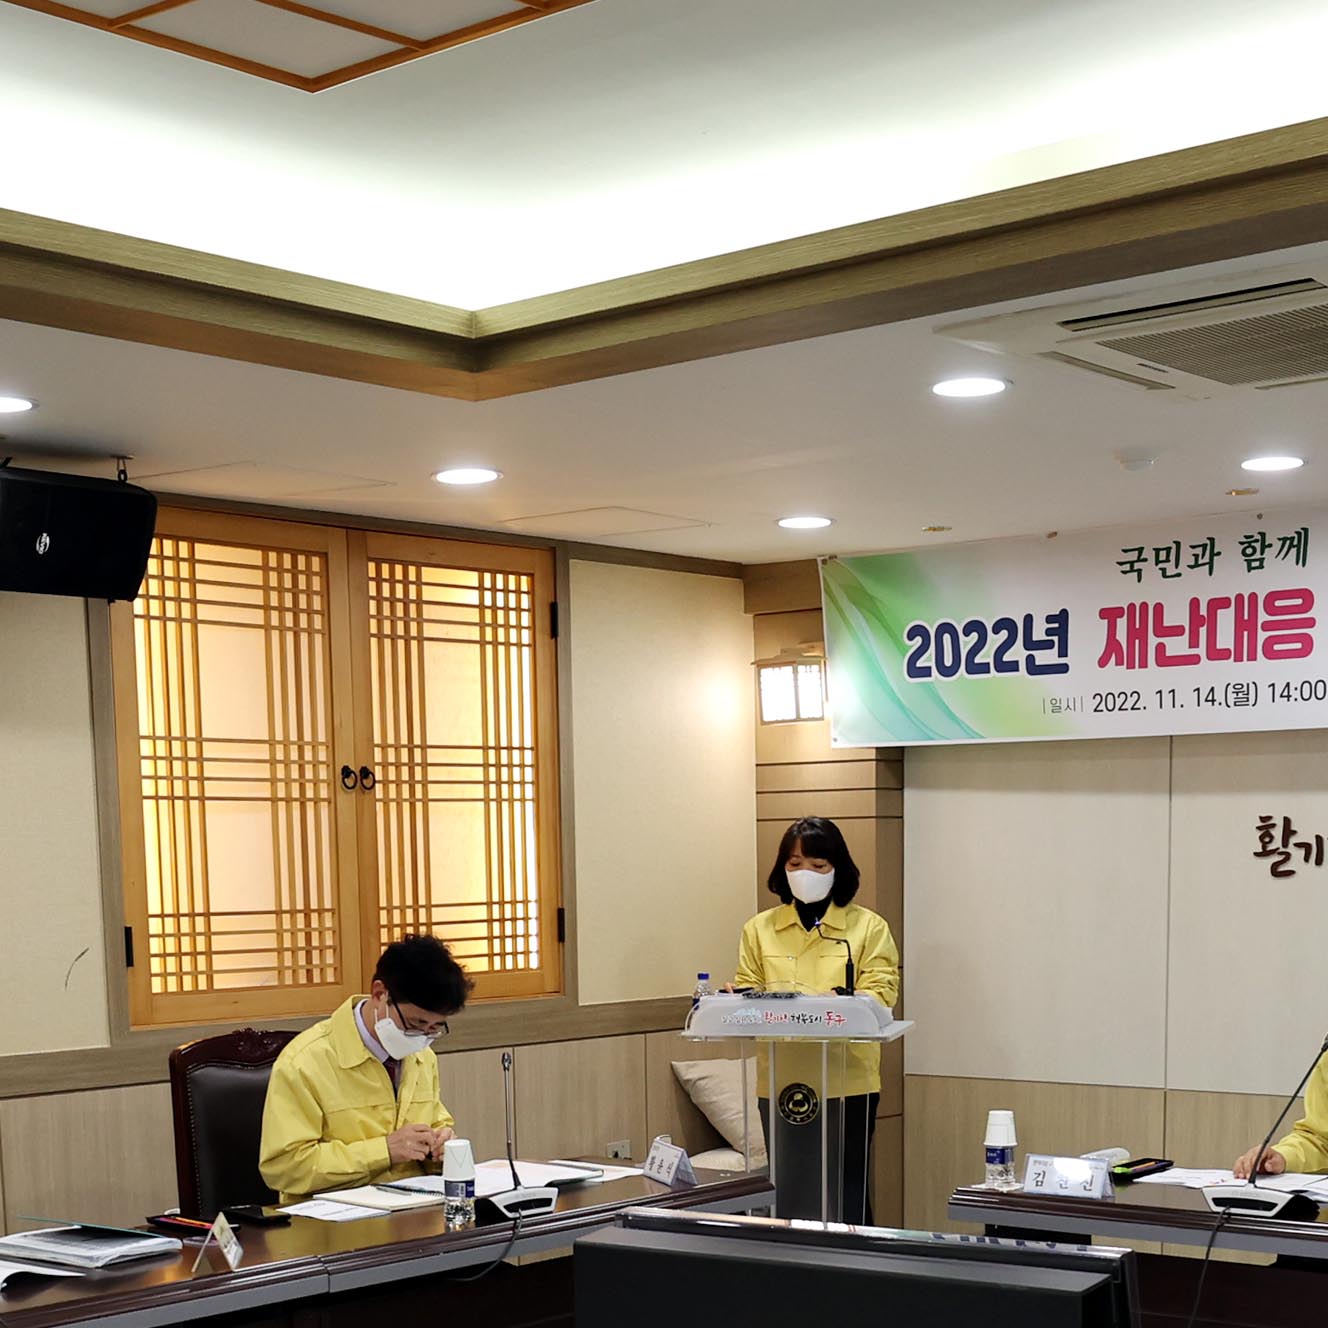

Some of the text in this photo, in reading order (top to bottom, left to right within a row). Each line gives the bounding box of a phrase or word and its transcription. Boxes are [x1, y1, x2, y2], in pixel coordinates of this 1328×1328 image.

[1116, 536, 1222, 583] 국민과
[1238, 527, 1310, 573] 함께
[905, 607, 1071, 680] 2022년
[1097, 588, 1317, 670] 재난대응
[1092, 690, 1148, 713] 2022.
[1154, 688, 1185, 710] 11.
[1193, 681, 1259, 709] 14.(월)
[1267, 679, 1328, 704] 14:00
